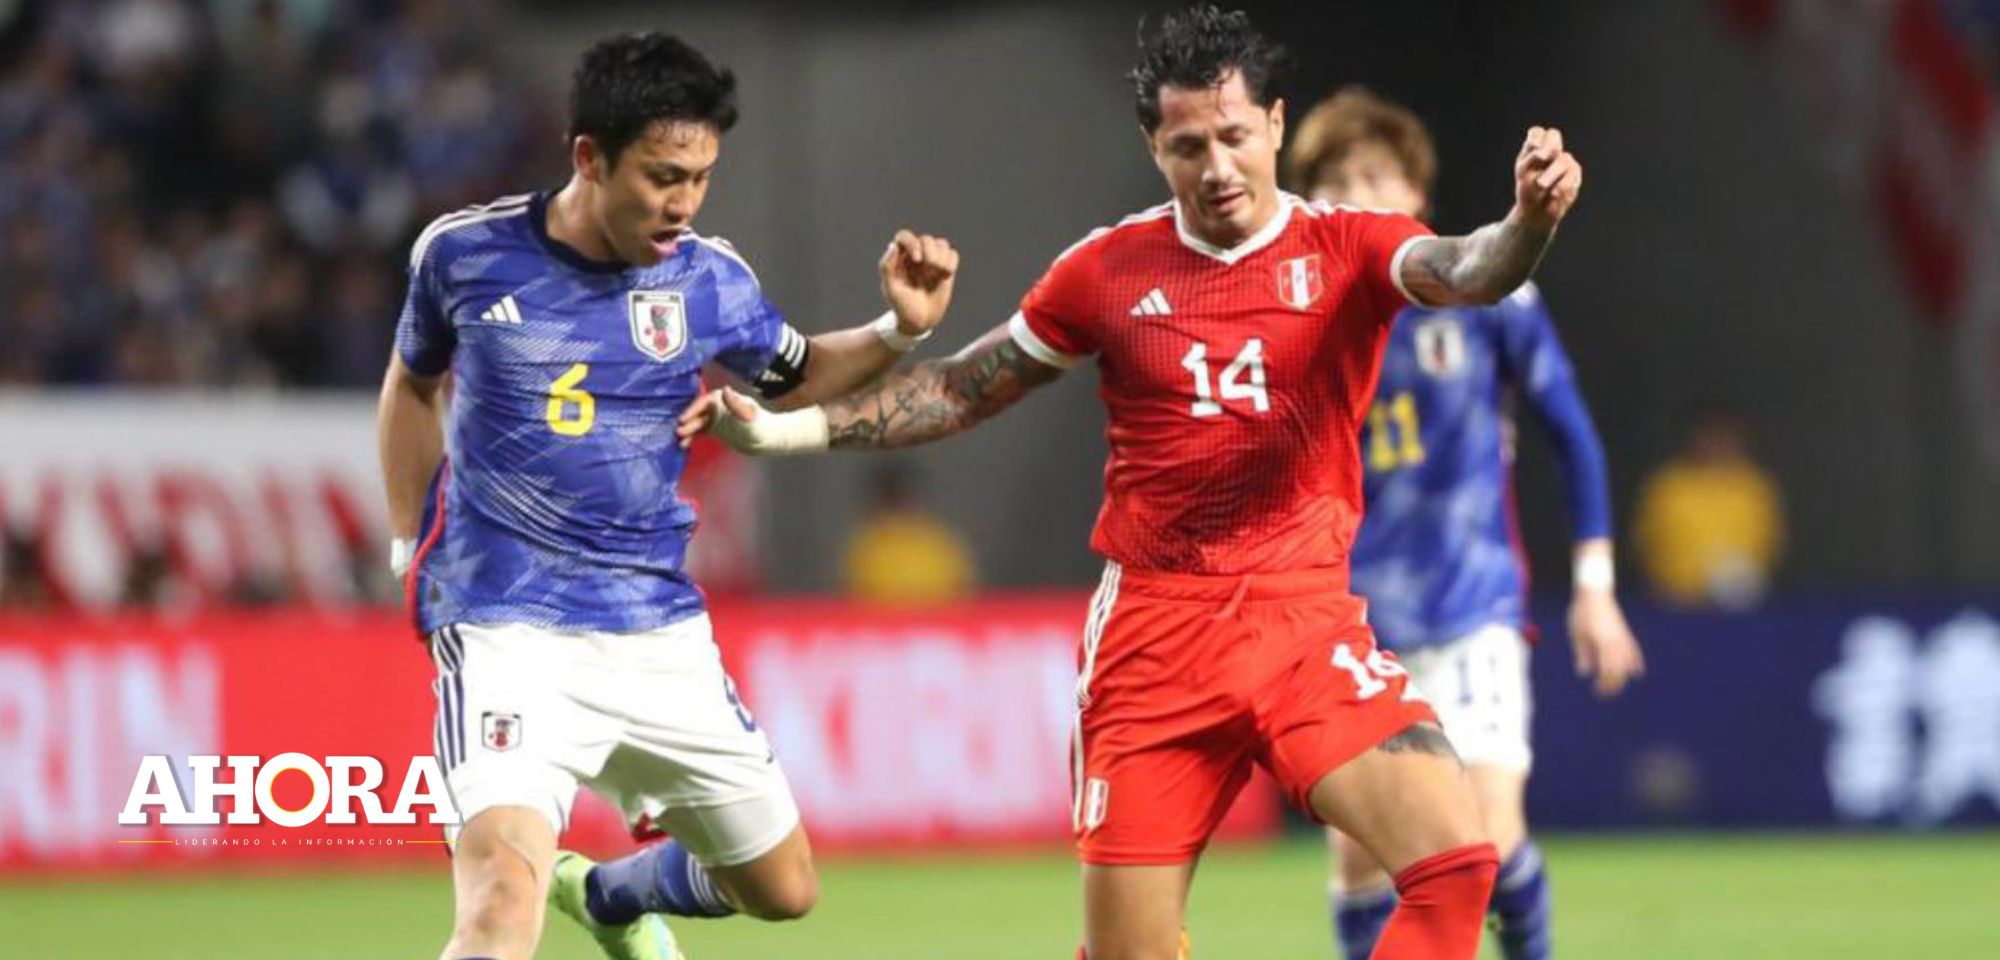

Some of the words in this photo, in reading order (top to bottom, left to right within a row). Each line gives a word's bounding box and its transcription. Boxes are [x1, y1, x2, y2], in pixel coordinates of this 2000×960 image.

[546, 363, 595, 436] 6
[1181, 338, 1269, 417] 14
[1368, 391, 1426, 471] 11
